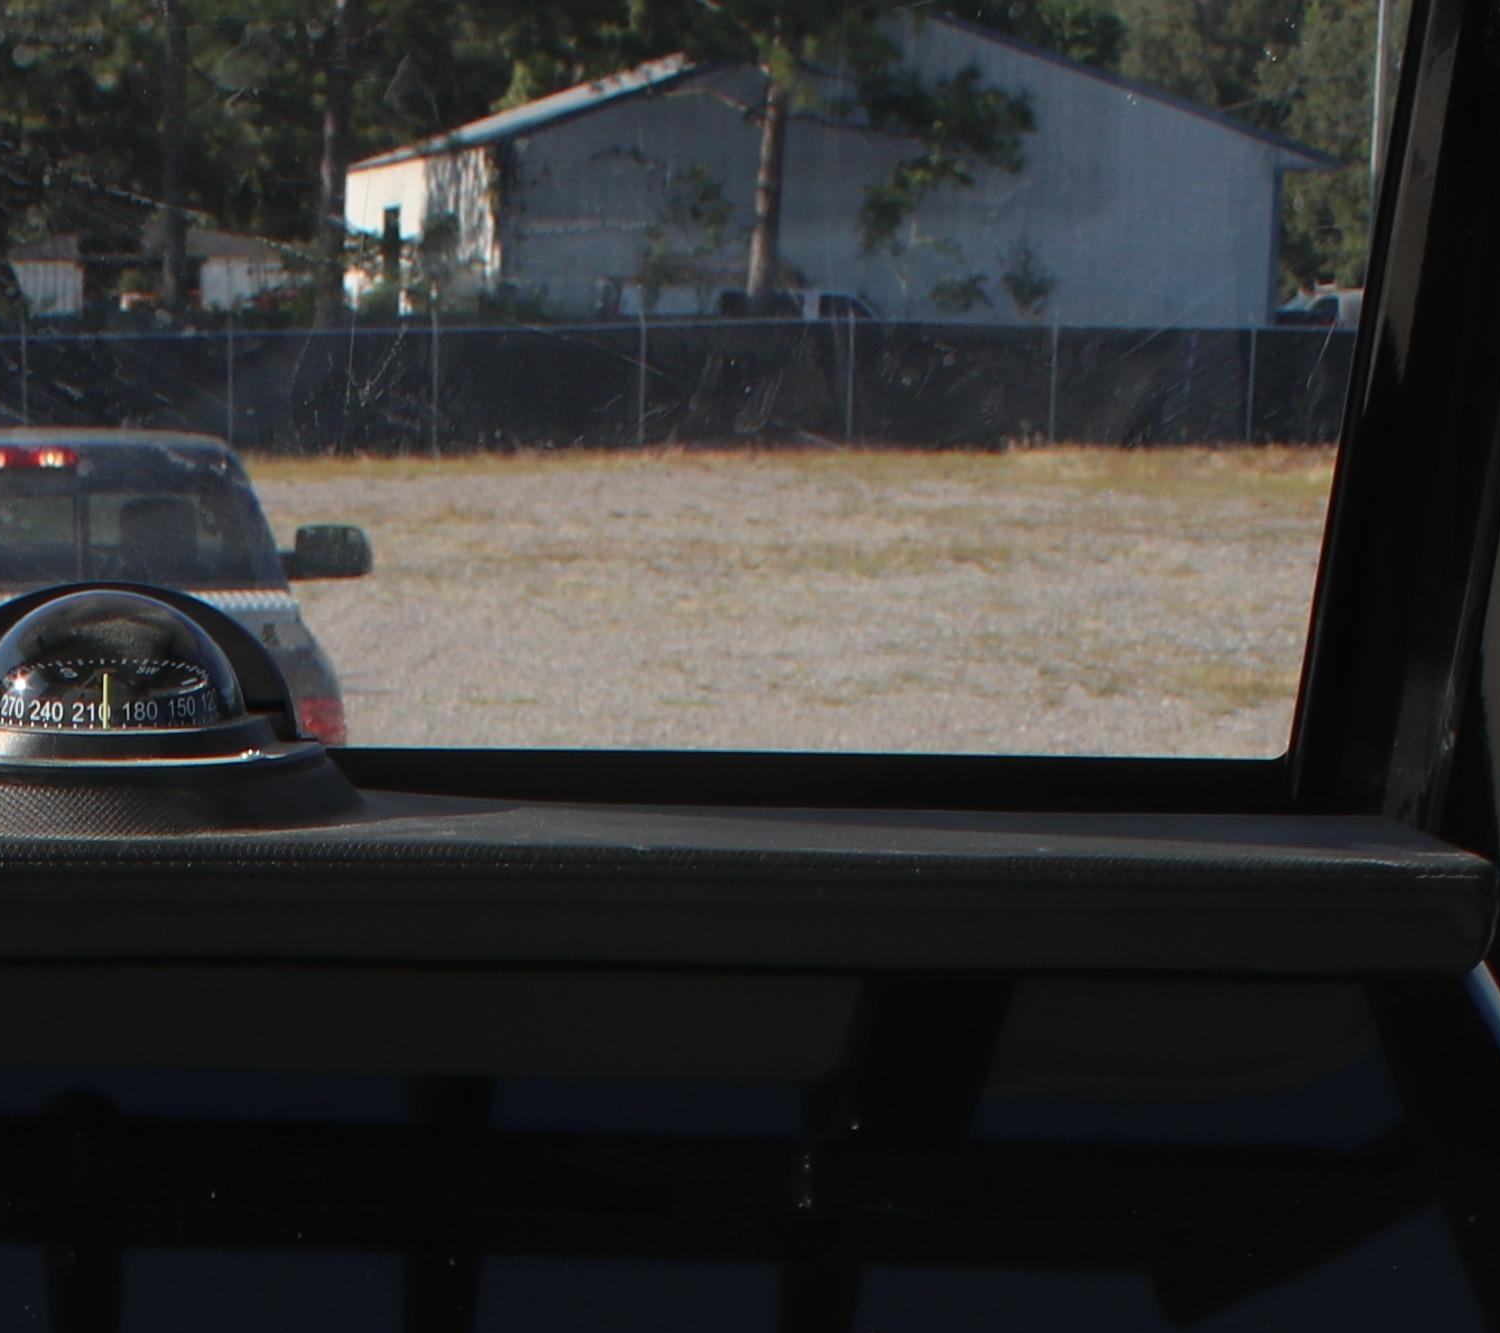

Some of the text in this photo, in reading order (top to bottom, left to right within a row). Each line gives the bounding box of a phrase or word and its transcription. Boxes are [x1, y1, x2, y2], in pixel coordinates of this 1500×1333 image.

[1, 691, 24, 719] 270
[30, 702, 64, 722] 240
[72, 702, 111, 722] 210
[122, 702, 158, 721] 180
[168, 696, 196, 717] 150
